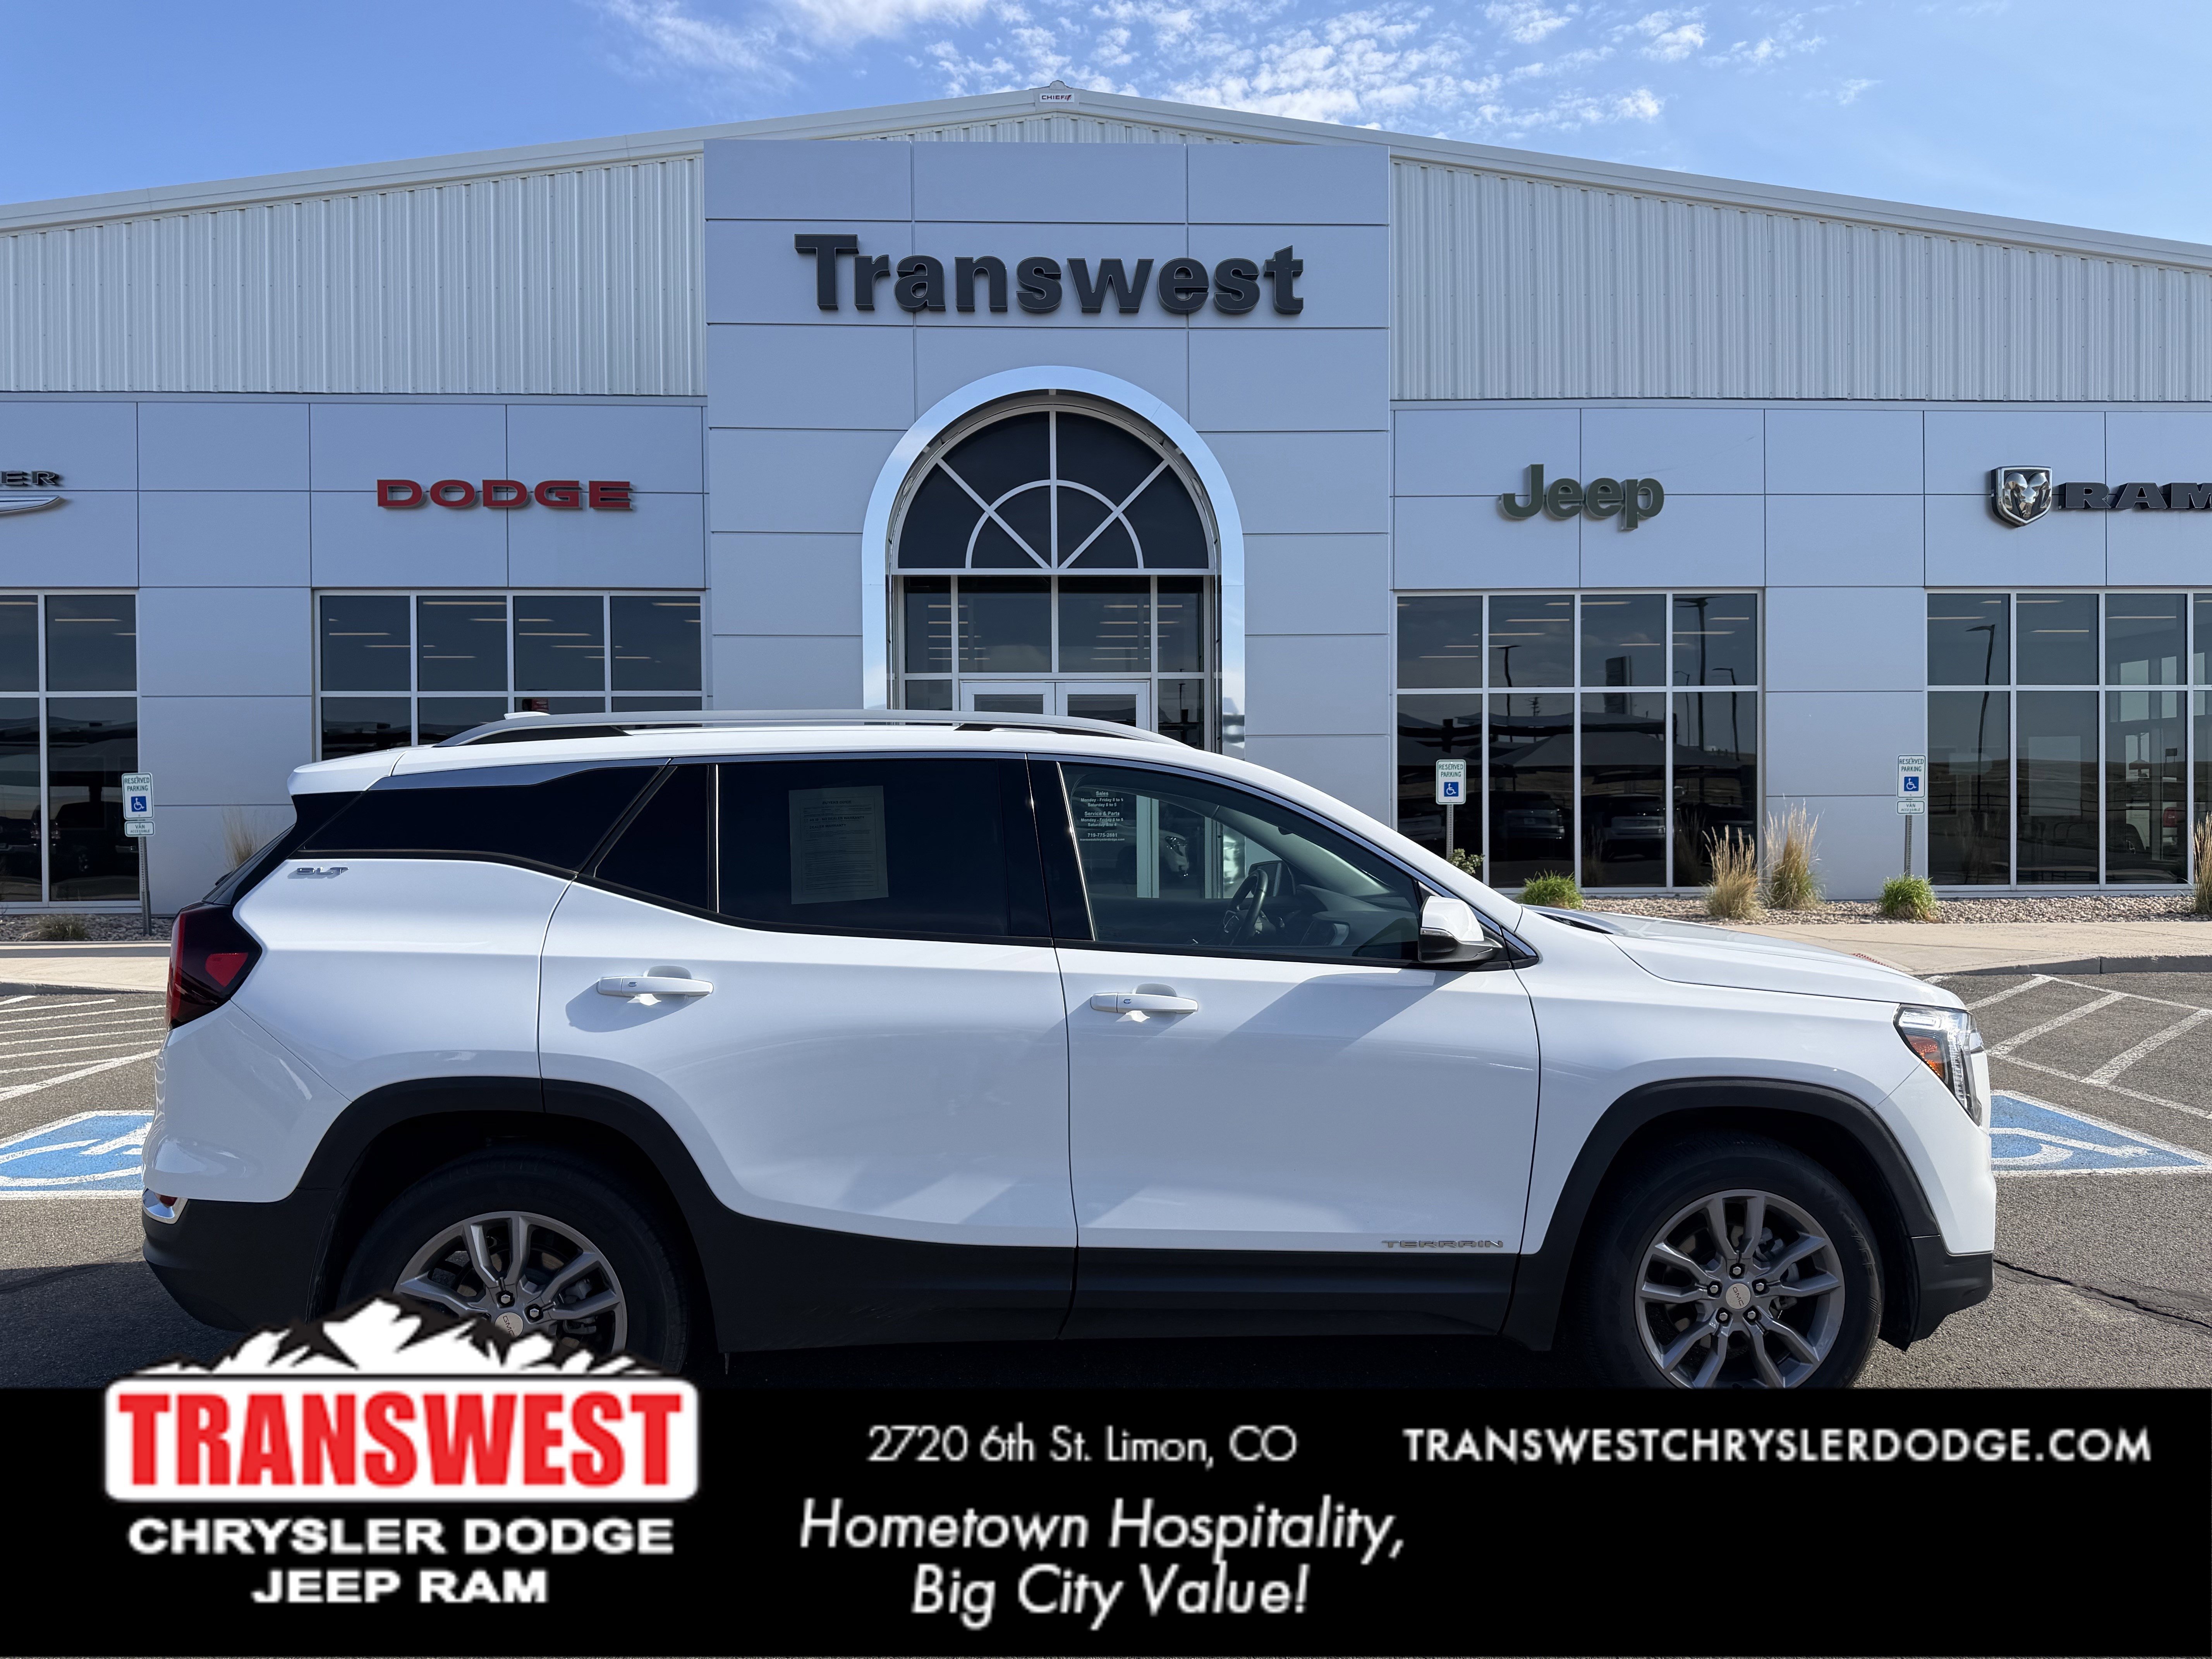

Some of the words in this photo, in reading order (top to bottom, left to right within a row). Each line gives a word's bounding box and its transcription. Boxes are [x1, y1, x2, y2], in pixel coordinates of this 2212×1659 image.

[794, 234, 1304, 314] Transwest
[377, 479, 632, 508] DODGE
[1499, 464, 1664, 531] Jeep
[2059, 482, 2212, 509] RAM
[297, 867, 349, 875] SLT
[1381, 1240, 1503, 1248] TERRAIN
[1733, 1287, 1744, 1306] GMC
[503, 1316, 515, 1336] GMC
